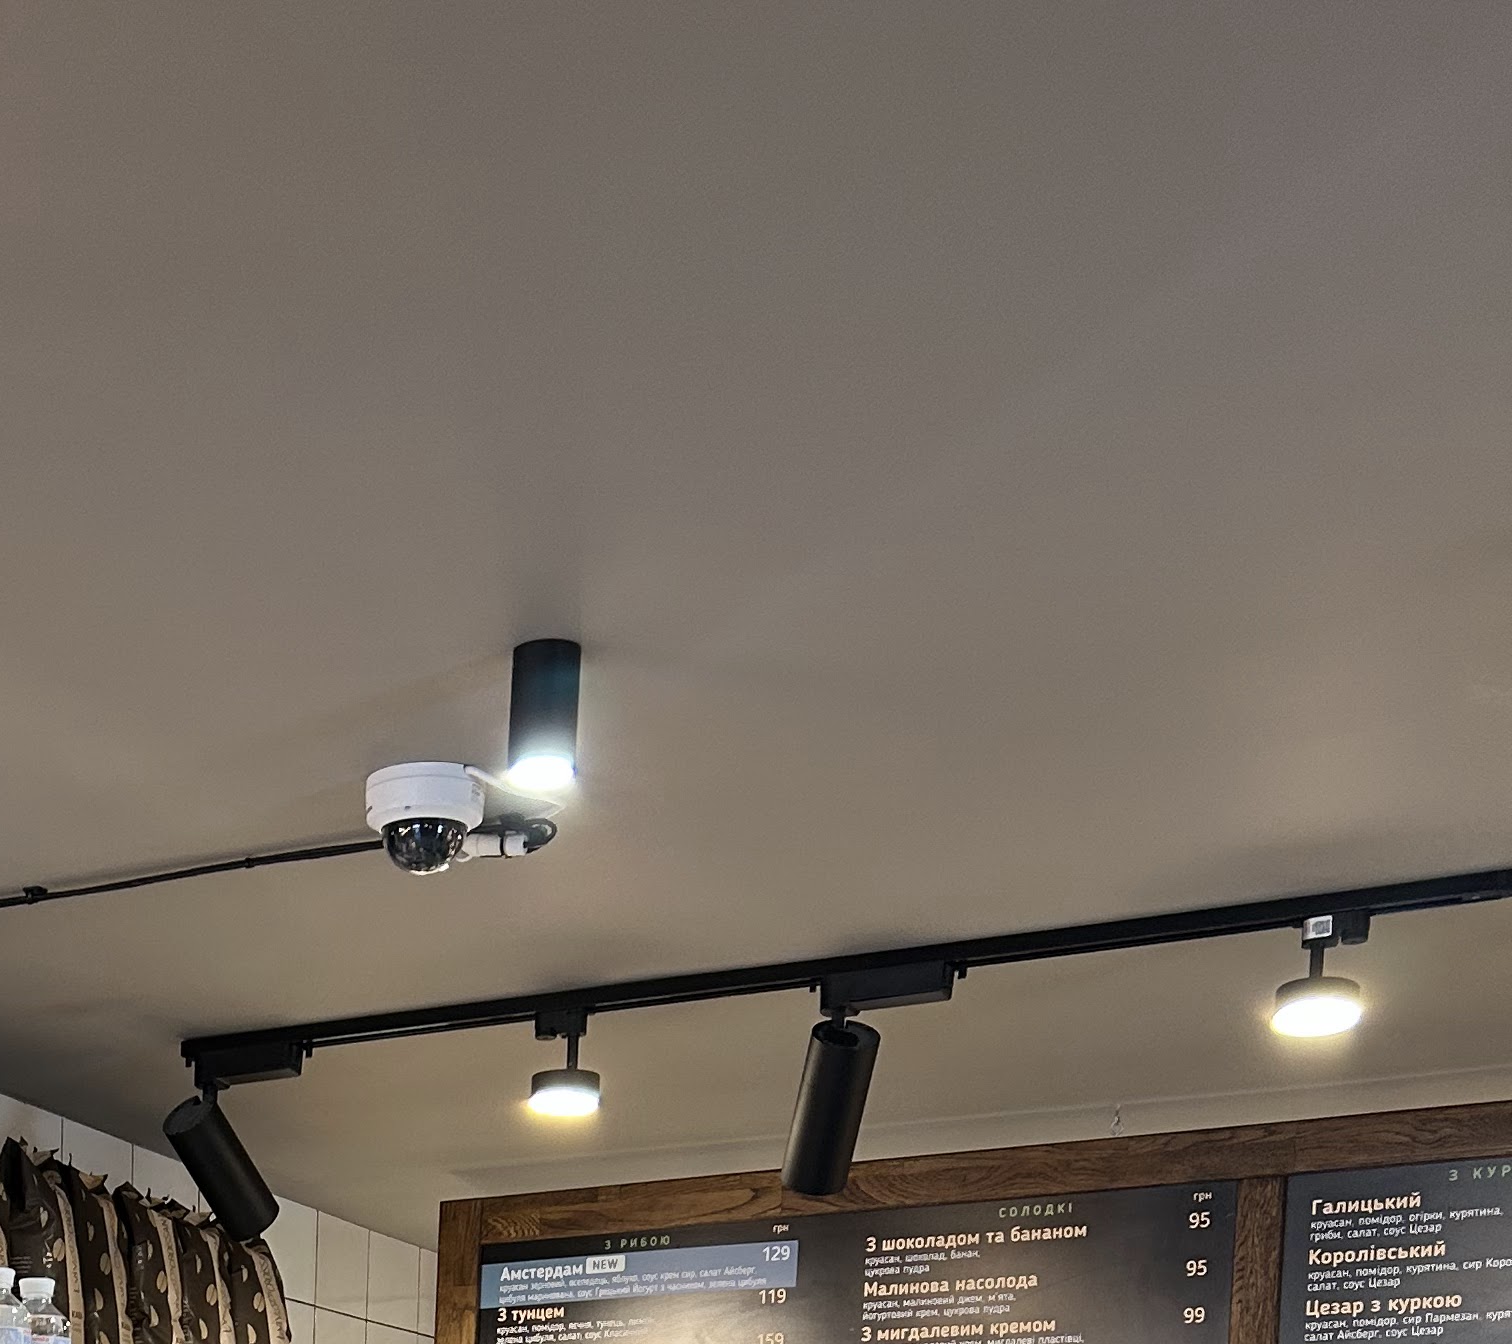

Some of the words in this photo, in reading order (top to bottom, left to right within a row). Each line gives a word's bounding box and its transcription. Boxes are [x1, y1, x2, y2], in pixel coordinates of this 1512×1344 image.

[1449, 1170, 1458, 1181] З
[1473, 1165, 1512, 1179] КУР
[1193, 1191, 1212, 1202] грн
[1311, 1192, 1421, 1216] Галицький
[999, 1203, 1073, 1218] СОЛОДКІ
[1189, 1211, 1211, 1229] 95
[773, 1224, 789, 1234] грн
[620, 1235, 671, 1249] РИБОЮ
[866, 1237, 876, 1252] З
[882, 1231, 979, 1252] шоколадом
[986, 1231, 1005, 1244] та
[1010, 1225, 1088, 1242] бананом
[762, 1246, 790, 1262] 129
[1308, 1241, 1446, 1267] Королівський
[500, 1264, 583, 1281] Амстердам
[593, 1259, 618, 1270] NEW
[1186, 1259, 1208, 1277] 95
[1463, 1260, 1482, 1270] сир
[863, 1280, 949, 1297] Малинова
[955, 1274, 1038, 1291] насолода
[759, 1288, 786, 1304] 119
[1306, 1300, 1364, 1318] Цезар
[1371, 1300, 1381, 1312] з
[1388, 1294, 1463, 1314] куркою
[497, 1308, 507, 1322] З
[511, 1306, 565, 1324] тунцем
[1183, 1307, 1205, 1324] 99
[1402, 1315, 1422, 1325] сир
[861, 1326, 872, 1342] З
[877, 1323, 983, 1343] мигдалевим
[990, 1319, 1056, 1337] кремом
[1304, 1333, 1334, 1341] салат
